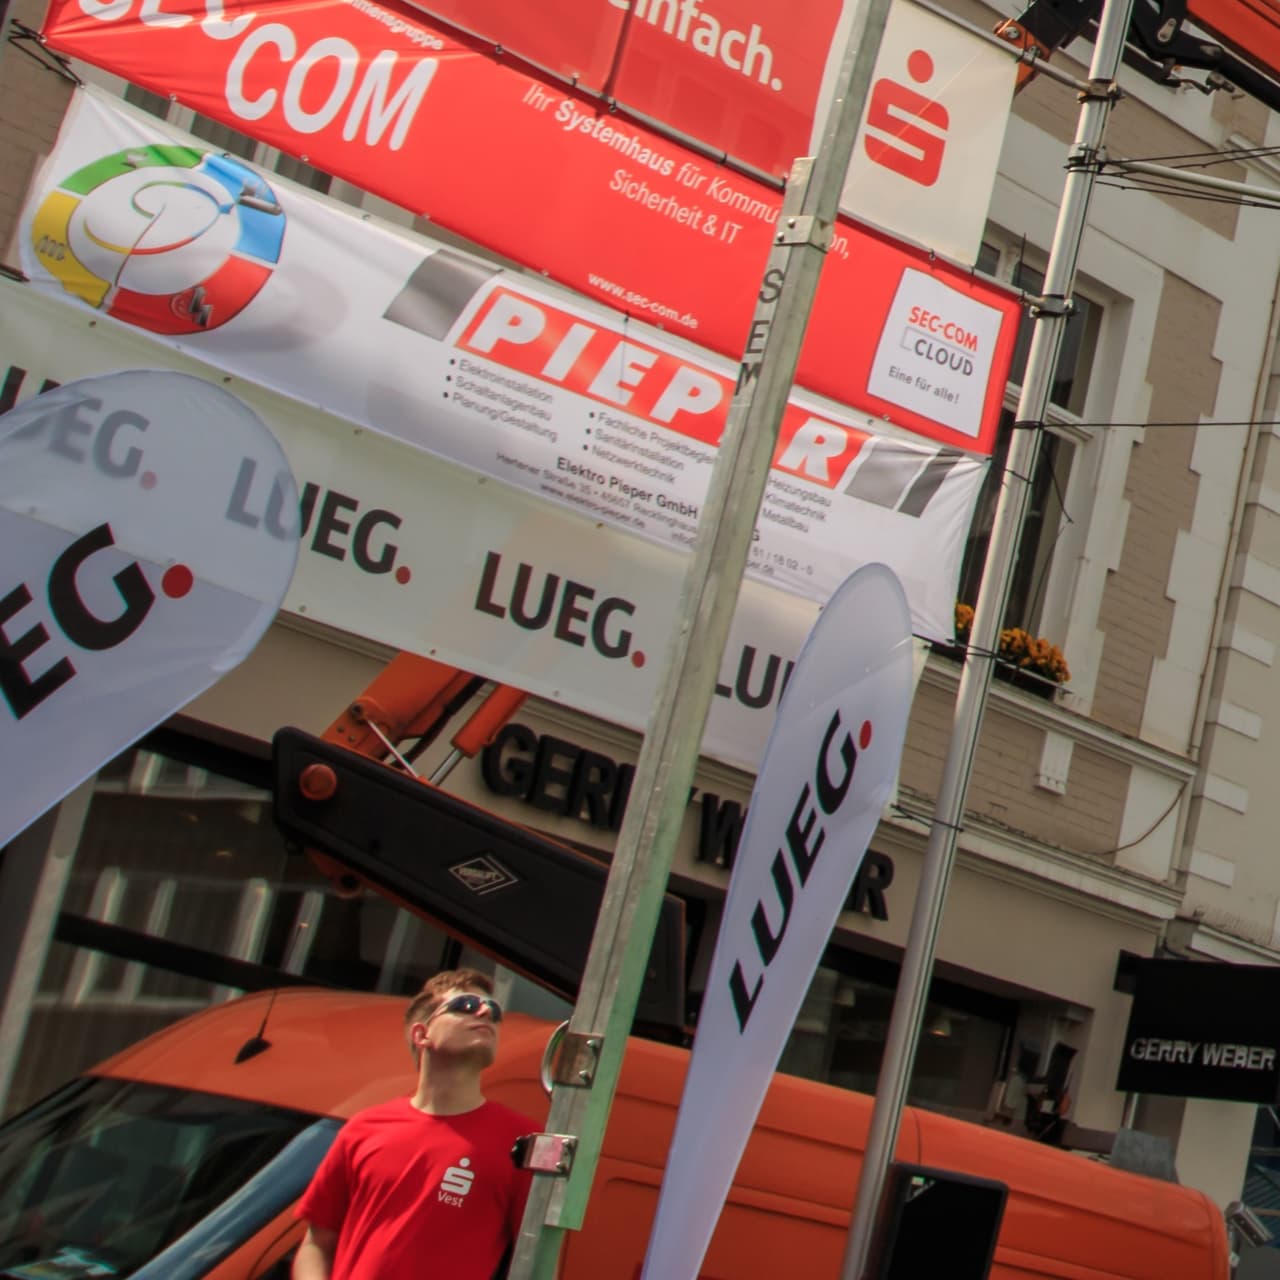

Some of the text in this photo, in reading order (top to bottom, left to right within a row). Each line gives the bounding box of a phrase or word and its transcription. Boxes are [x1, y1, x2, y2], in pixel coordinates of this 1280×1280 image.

[224, 22, 440, 152] COM
[522, 83, 850, 260] Ihr Systemhaus für Kommuon,
[609, 168, 744, 246] Sicherheit & IT
[587, 272, 700, 330] www.sec-com.de
[908, 305, 978, 352] SEC-COM
[465, 292, 852, 483] PIEPR
[888, 365, 960, 405] Eine für alle!
[914, 338, 974, 377] CLOUD
[225, 456, 411, 585] LUEG.
[556, 456, 606, 487] Elektro
[608, 475, 654, 505] Pieper
[656, 493, 699, 520] GmbH
[474, 550, 646, 669] LUEG.
[481, 720, 698, 833] GER
[728, 707, 873, 1036] LUEG.
[1130, 1037, 1277, 1071] GERRY WEBER
[438, 1190, 464, 1208] Vest
